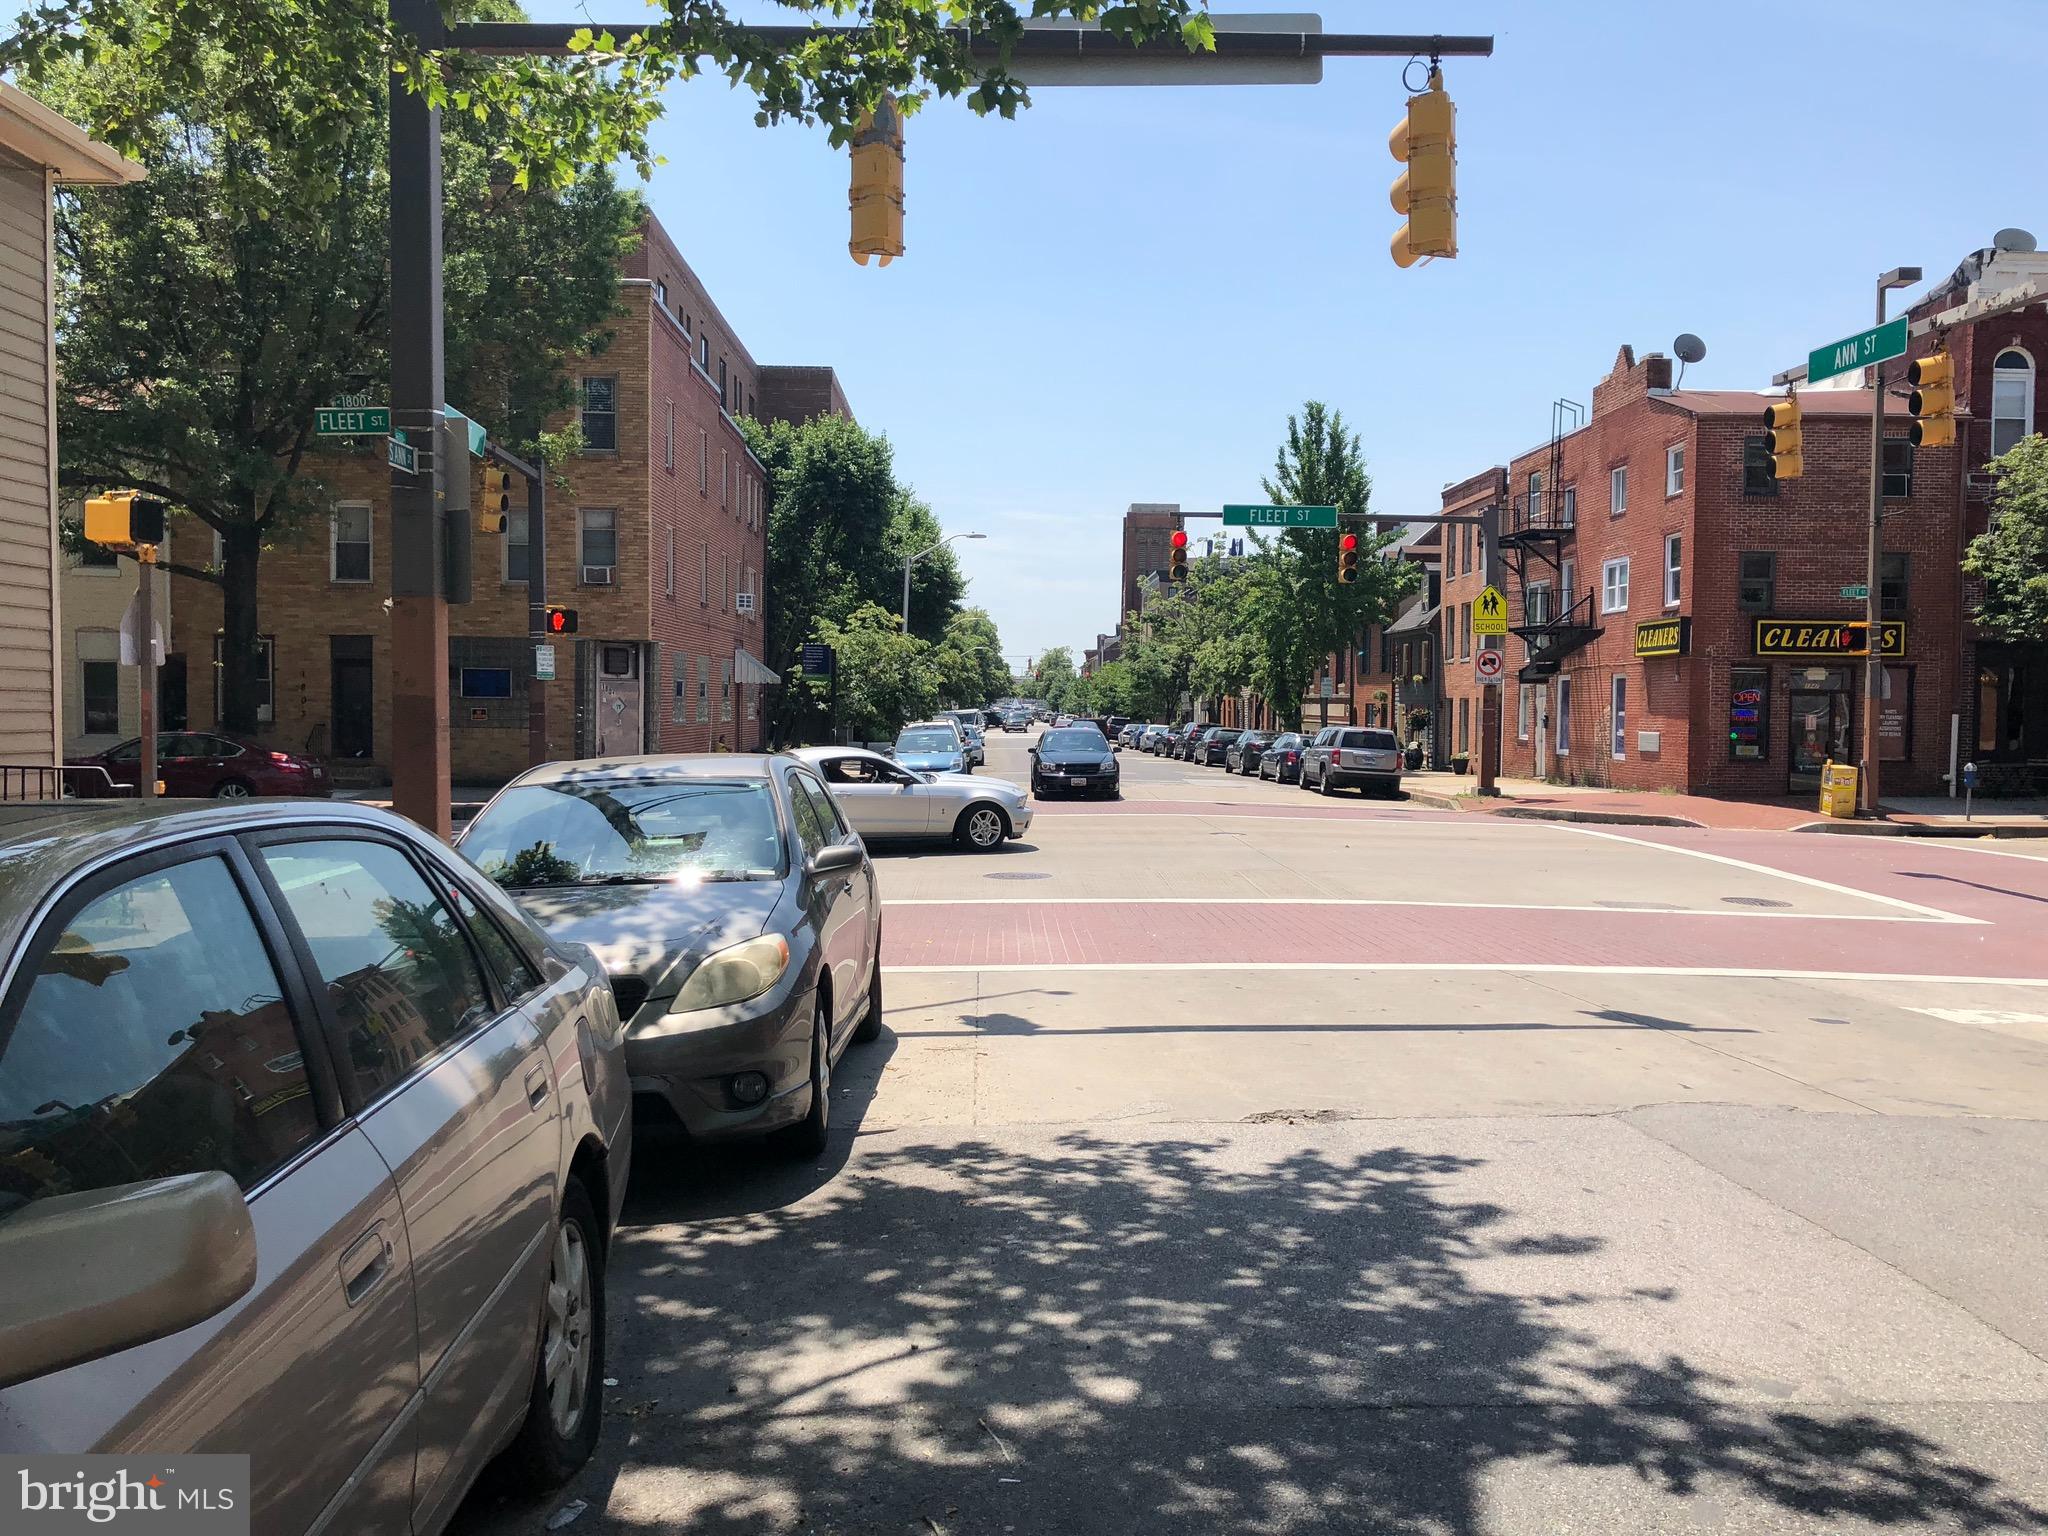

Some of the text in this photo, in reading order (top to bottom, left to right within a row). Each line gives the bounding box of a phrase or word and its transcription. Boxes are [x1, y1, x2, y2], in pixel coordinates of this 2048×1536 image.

[1834, 334, 1877, 370] ANN ST
[342, 395, 366, 407] 1800
[320, 413, 365, 430] FLEET
[1249, 509, 1310, 523] FLEET ST
[1475, 623, 1505, 631] SCHOOL
[1638, 626, 1679, 648] CLEANERS
[1734, 692, 1760, 702] OPEN
